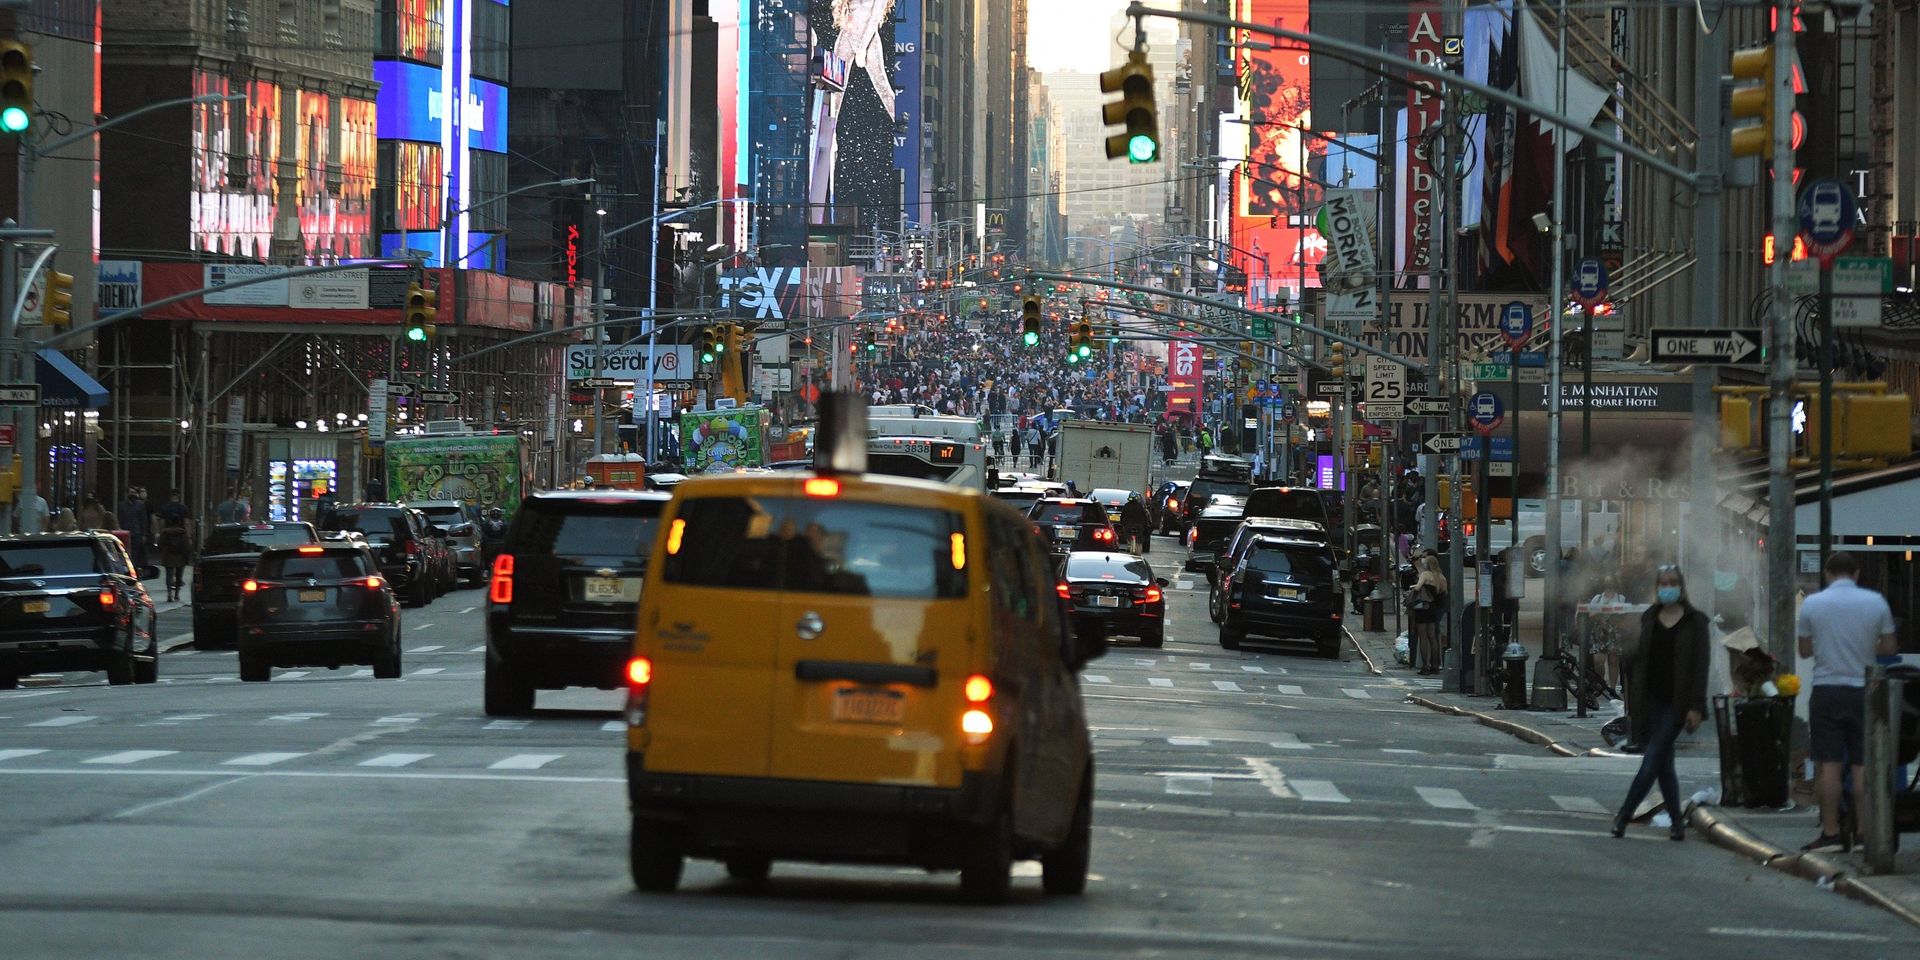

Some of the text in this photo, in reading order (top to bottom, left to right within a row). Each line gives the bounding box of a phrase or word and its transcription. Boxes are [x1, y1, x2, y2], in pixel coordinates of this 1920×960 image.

[719, 267, 784, 319] TSX
[1666, 340, 1746, 354] ONE WAY
[1485, 365, 1496, 378] 52
[11, 390, 32, 400] WAY
[1370, 381, 1401, 399] 25
[1541, 384, 1567, 396] TE
[1412, 402, 1450, 411] ONE WA
[904, 444, 930, 454] 3838
[1433, 439, 1454, 448] ONE
